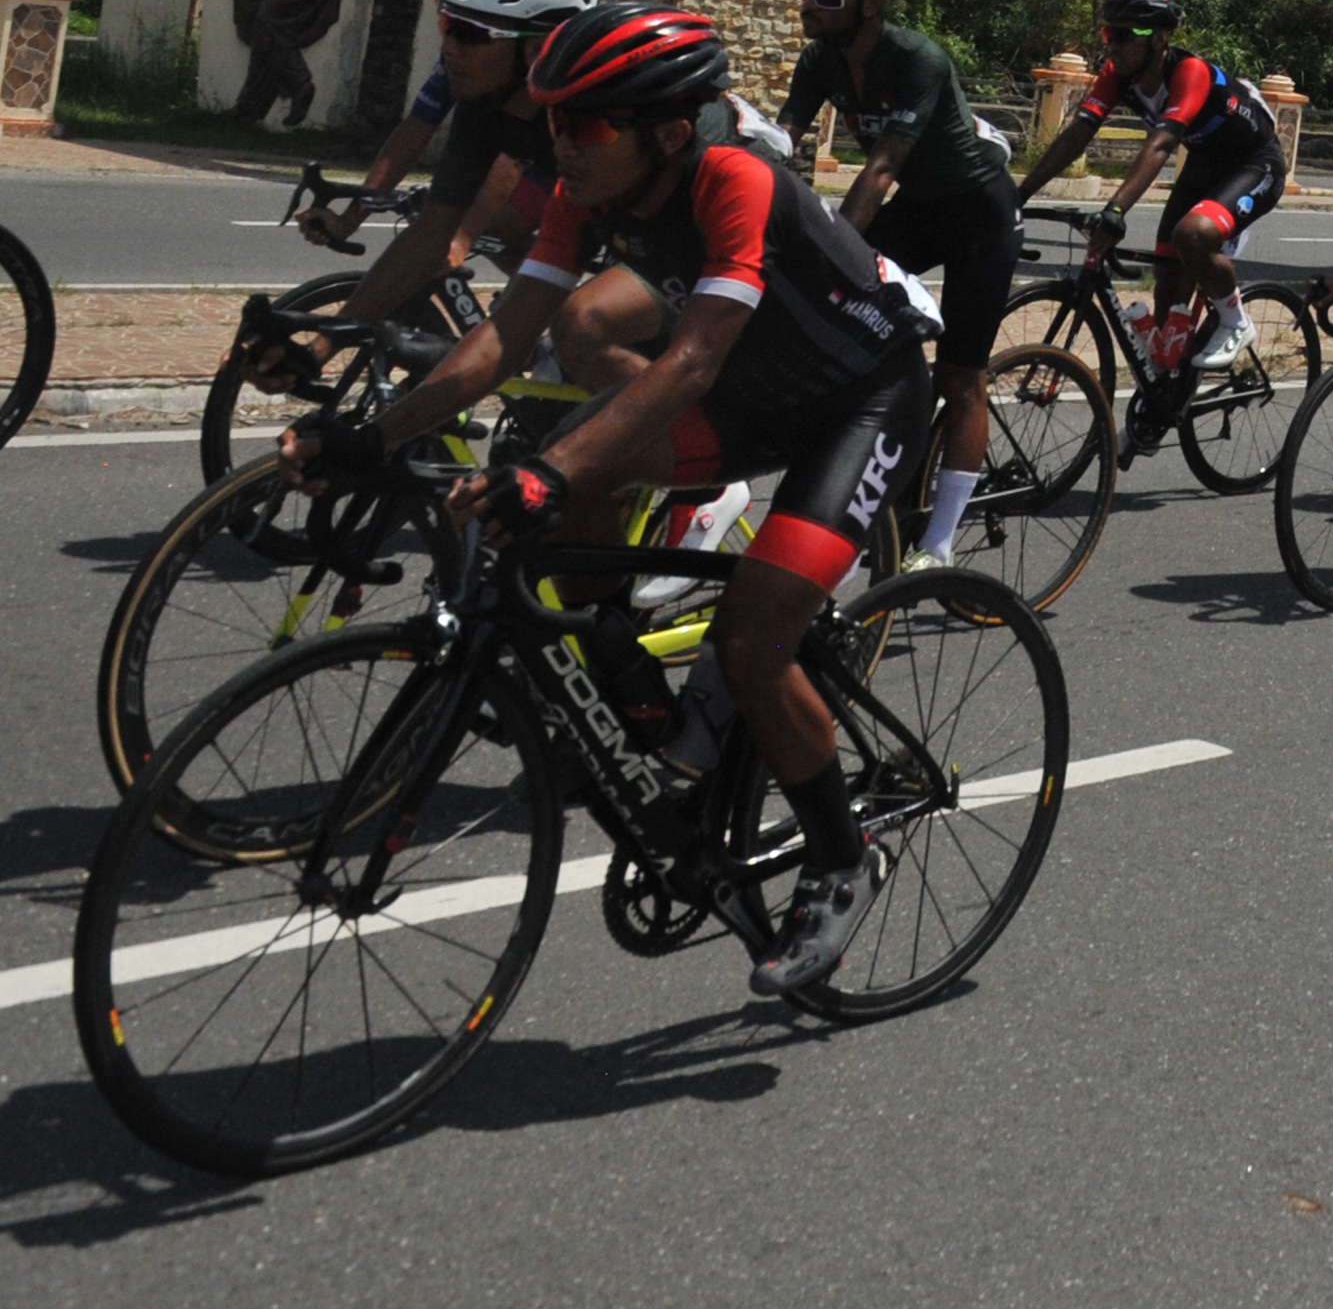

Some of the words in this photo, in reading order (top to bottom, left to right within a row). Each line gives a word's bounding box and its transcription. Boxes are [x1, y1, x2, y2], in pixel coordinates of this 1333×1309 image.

[842, 299, 895, 341] MAHRUS
[846, 432, 904, 531] KFC
[541, 637, 661, 806] DOGMA
